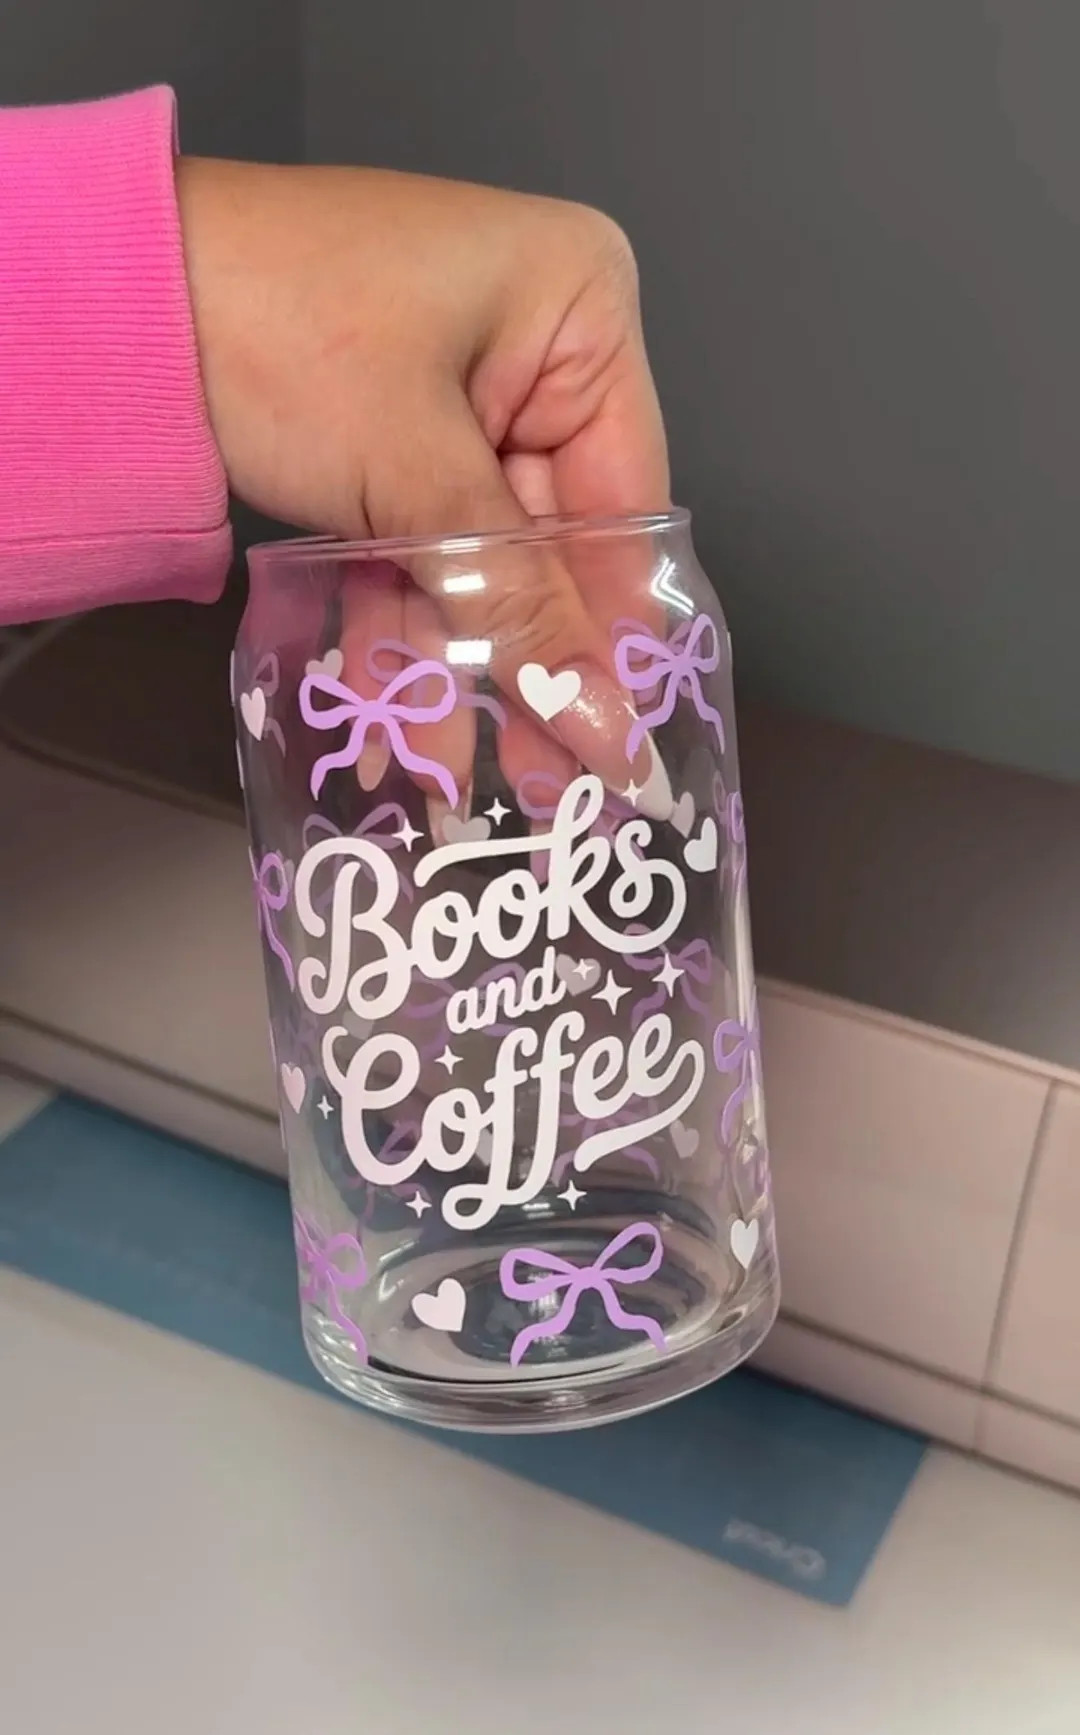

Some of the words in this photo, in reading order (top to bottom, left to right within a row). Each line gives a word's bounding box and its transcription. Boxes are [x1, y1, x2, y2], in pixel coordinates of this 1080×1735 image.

[295, 774, 687, 1020] Books
[446, 946, 567, 1034] and
[322, 1011, 705, 1230] Coffee
